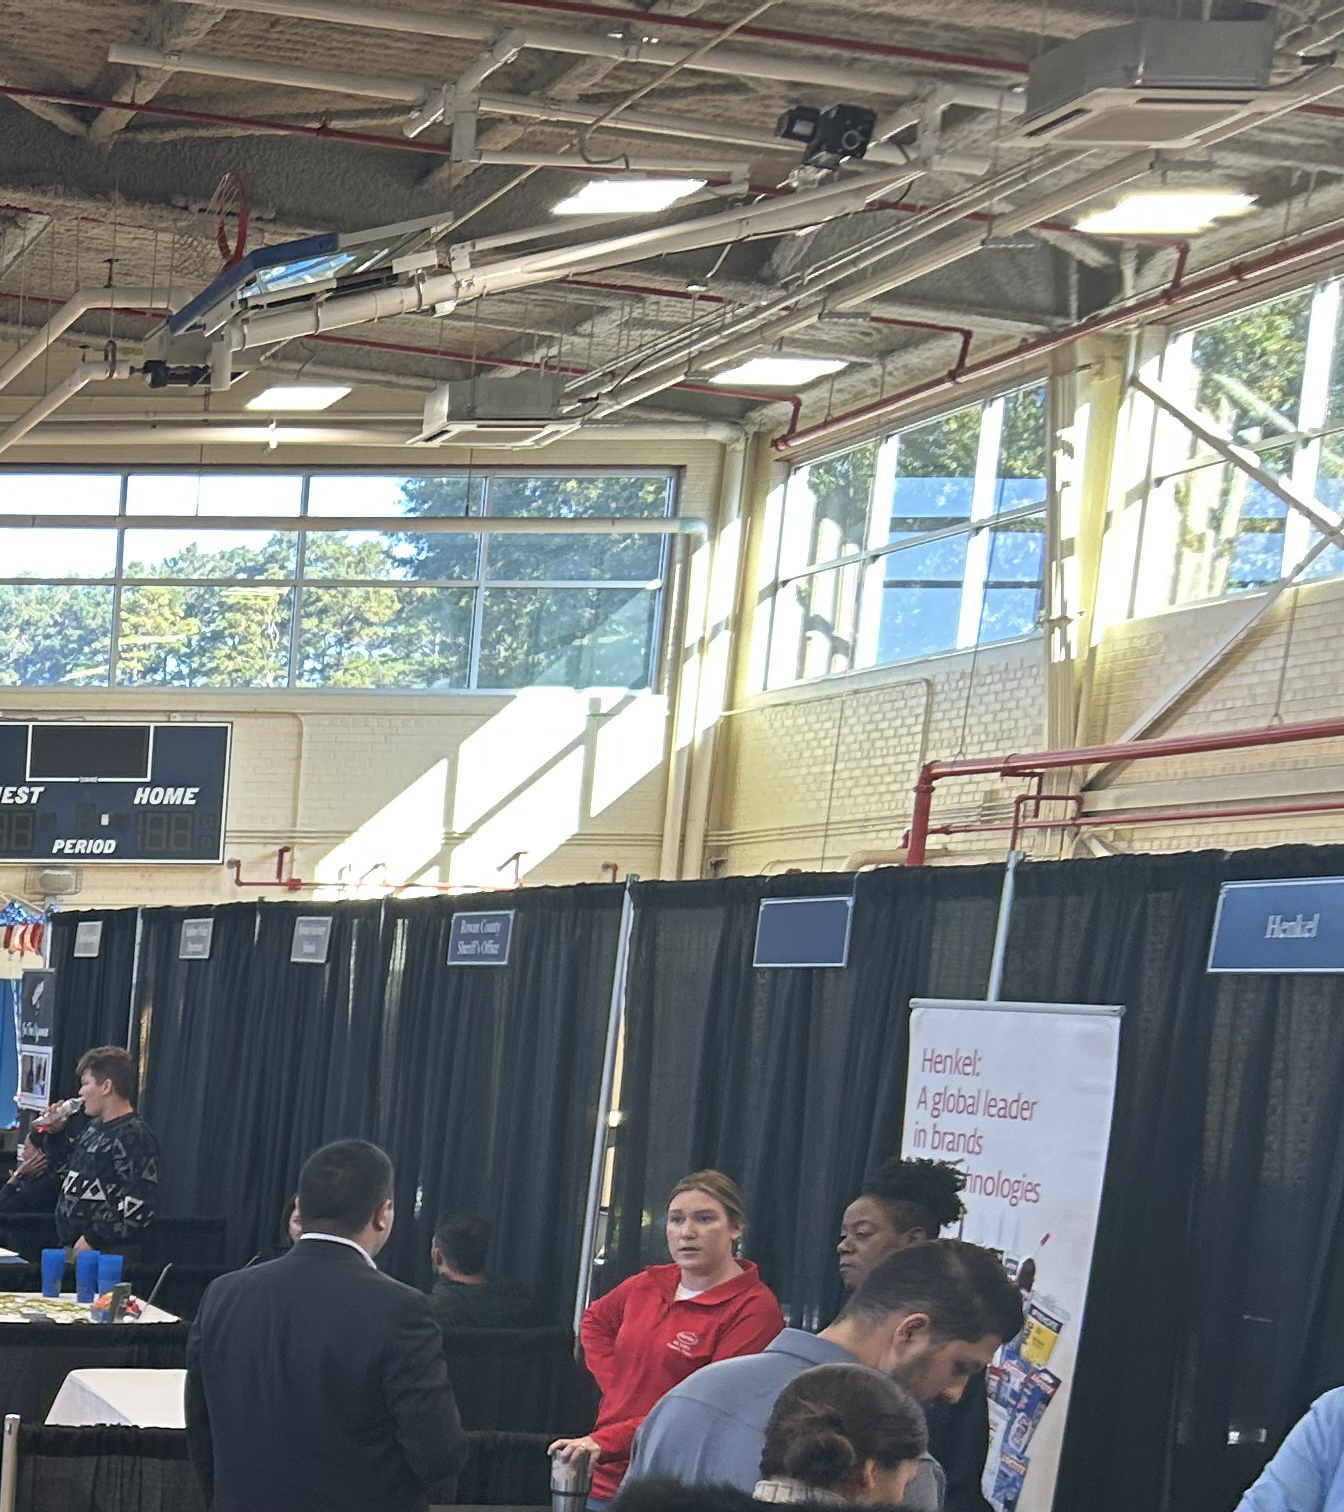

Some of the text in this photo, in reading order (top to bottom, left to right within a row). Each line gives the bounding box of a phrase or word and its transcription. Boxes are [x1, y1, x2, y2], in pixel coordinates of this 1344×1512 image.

[133, 787, 199, 805] HOME
[52, 839, 116, 854] PERIOD
[1264, 913, 1320, 938] Henkel
[921, 1048, 982, 1077] Henkel:
[916, 1086, 1038, 1121] A global leader
[913, 1121, 984, 1155] in brands
[963, 1166, 1041, 1207] hnologies
